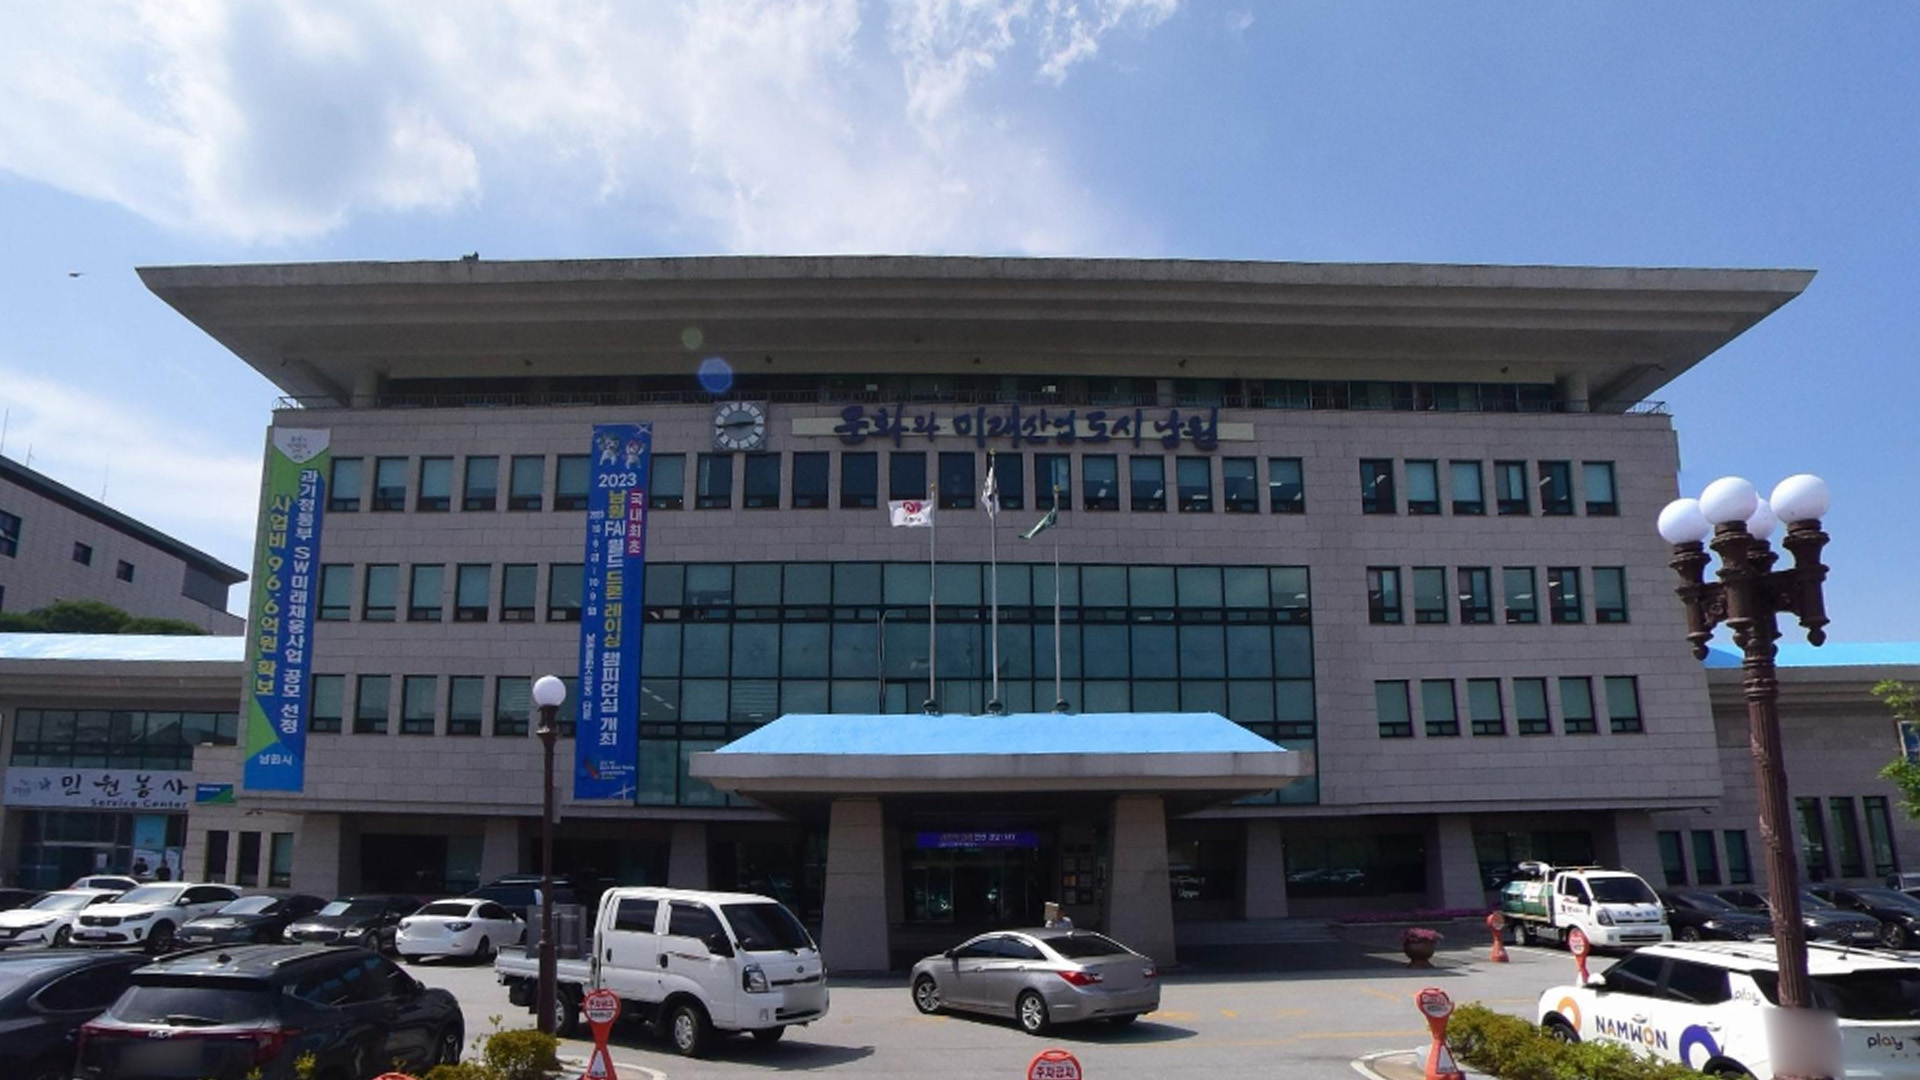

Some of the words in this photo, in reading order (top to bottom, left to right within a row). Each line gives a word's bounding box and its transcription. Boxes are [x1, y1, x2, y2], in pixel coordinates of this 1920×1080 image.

[833, 404, 945, 448] 문화와
[1153, 407, 1220, 451] 남원
[598, 474, 638, 488] 2023
[608, 489, 627, 519] 남원
[267, 495, 291, 549] 사업비
[604, 519, 626, 538] FAI
[606, 538, 625, 568] 월드
[605, 570, 624, 600] 드론
[603, 602, 622, 648] 레이싱
[255, 660, 278, 696] 확보
[282, 668, 302, 698] 공모
[600, 651, 621, 713] 챔피언십
[280, 703, 300, 734] 선정
[599, 716, 618, 746] 개최
[258, 753, 294, 766] 남원시
[91, 798, 137, 808] Service
[142, 799, 189, 809] Center
[1734, 987, 1762, 1007] play
[1595, 1014, 1669, 1051] NAMWON
[1867, 1030, 1904, 1051] play
